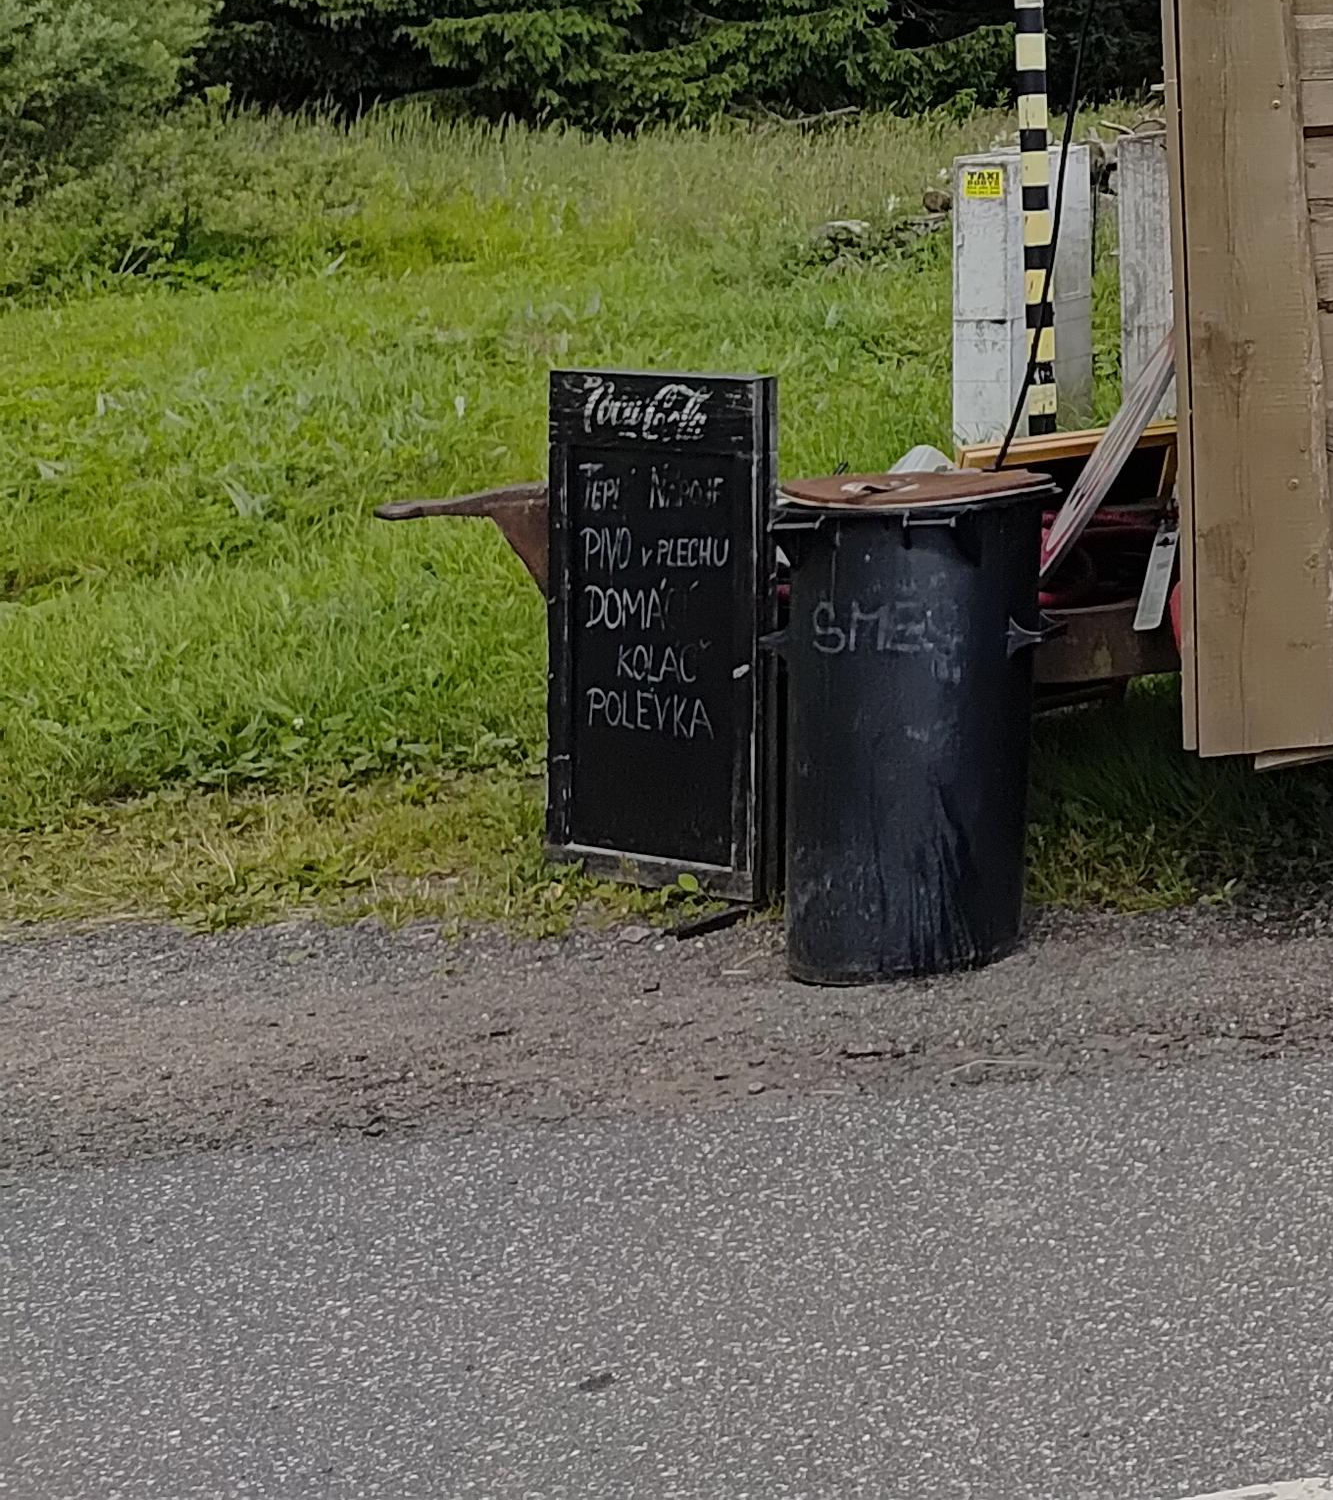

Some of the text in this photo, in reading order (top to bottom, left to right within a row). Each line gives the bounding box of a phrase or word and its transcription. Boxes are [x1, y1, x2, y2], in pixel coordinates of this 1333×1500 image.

[967, 171, 1000, 180] TAXI
[580, 527, 729, 575] PIVO v PLECHU
[586, 687, 714, 740] POLÉVKA
